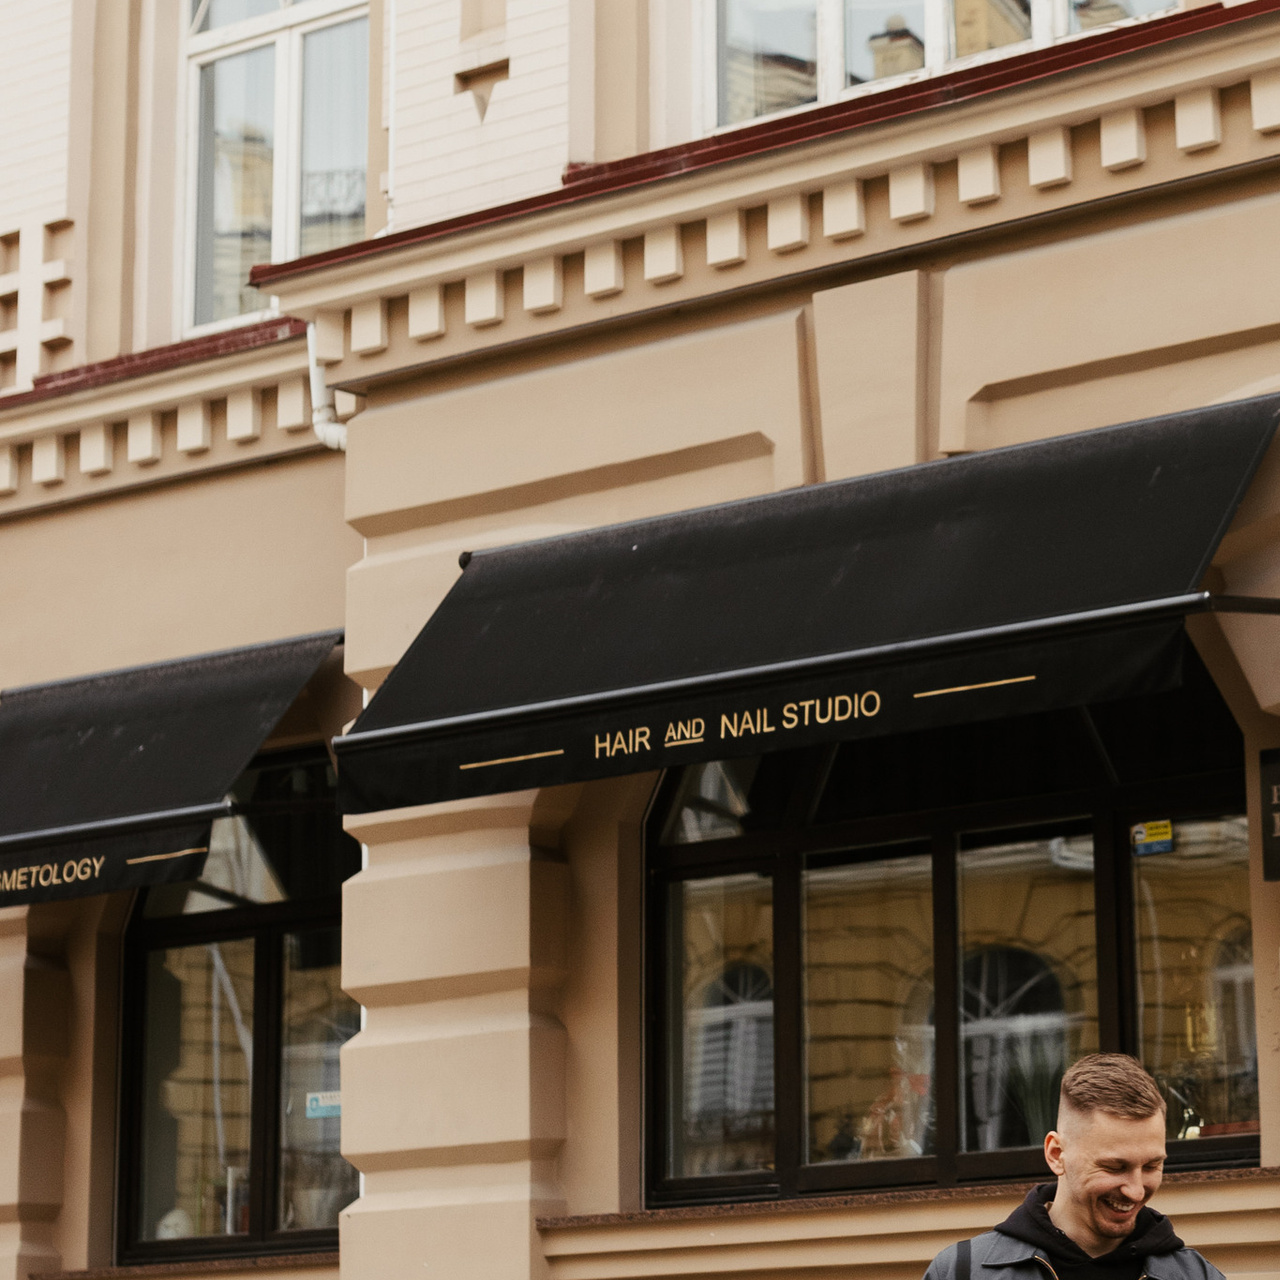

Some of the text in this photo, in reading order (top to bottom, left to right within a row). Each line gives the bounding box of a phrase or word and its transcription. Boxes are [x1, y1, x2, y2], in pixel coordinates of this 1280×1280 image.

[595, 690, 881, 759] HAIR AND NAIL STUDIO
[0, 855, 105, 891] METOLOGY
